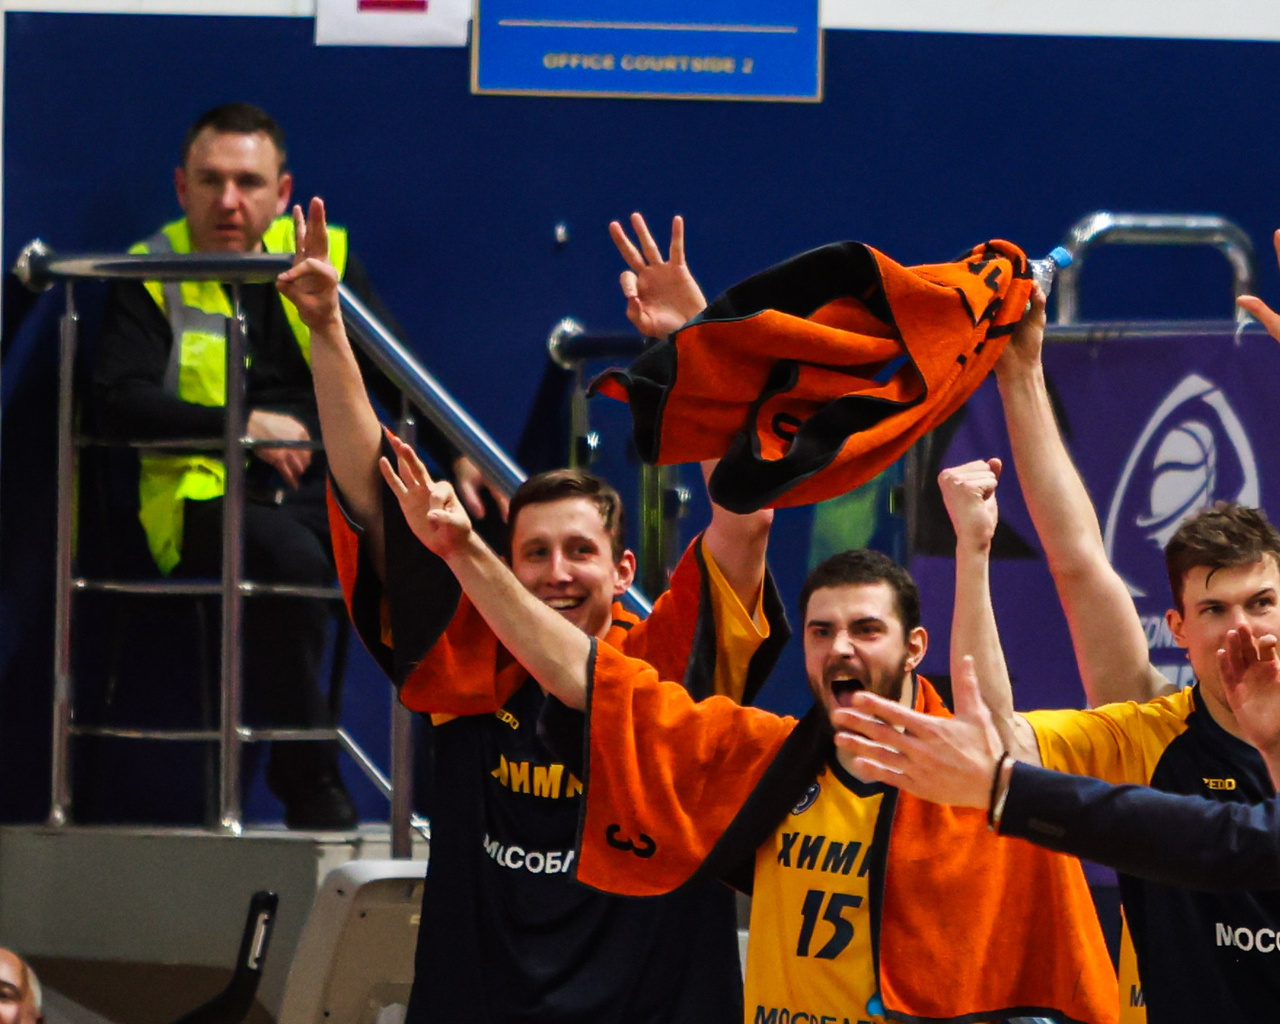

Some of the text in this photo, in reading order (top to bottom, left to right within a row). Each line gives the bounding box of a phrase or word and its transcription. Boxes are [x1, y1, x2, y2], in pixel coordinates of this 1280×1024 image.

[542, 53, 615, 71] OFFICE
[620, 54, 735, 73] COURTSIDE
[796, 889, 865, 961] 15
